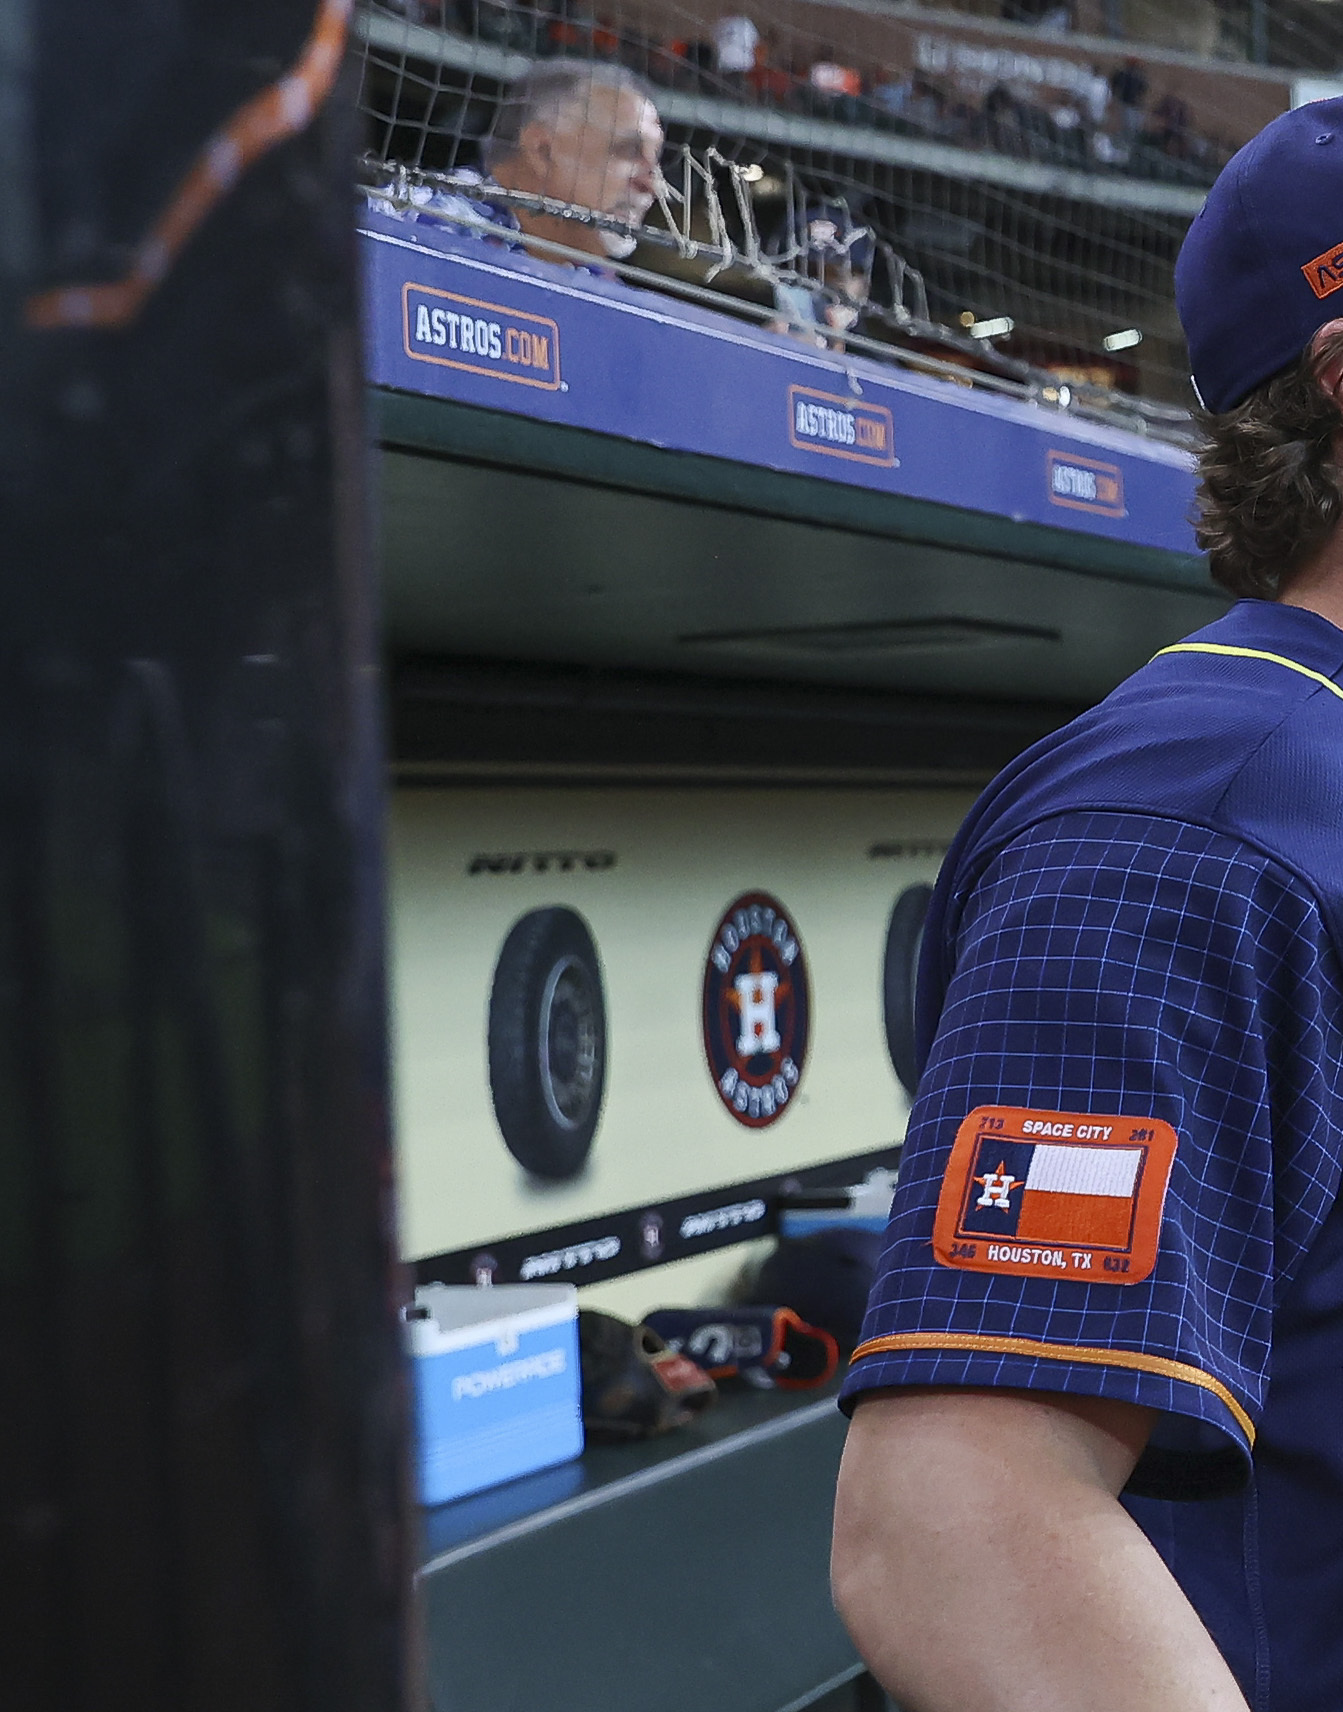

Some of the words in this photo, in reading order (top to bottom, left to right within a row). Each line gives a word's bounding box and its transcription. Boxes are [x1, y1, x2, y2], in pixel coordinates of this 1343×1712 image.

[415, 303, 550, 370] ASTROS.COM
[468, 851, 617, 877] NITTO
[733, 972, 782, 1057] H
[1022, 1119, 1075, 1139] SPACE
[1077, 1124, 1114, 1142] CITY
[987, 1244, 1068, 1270] HOUSTON,
[1071, 1251, 1093, 1270] TX
